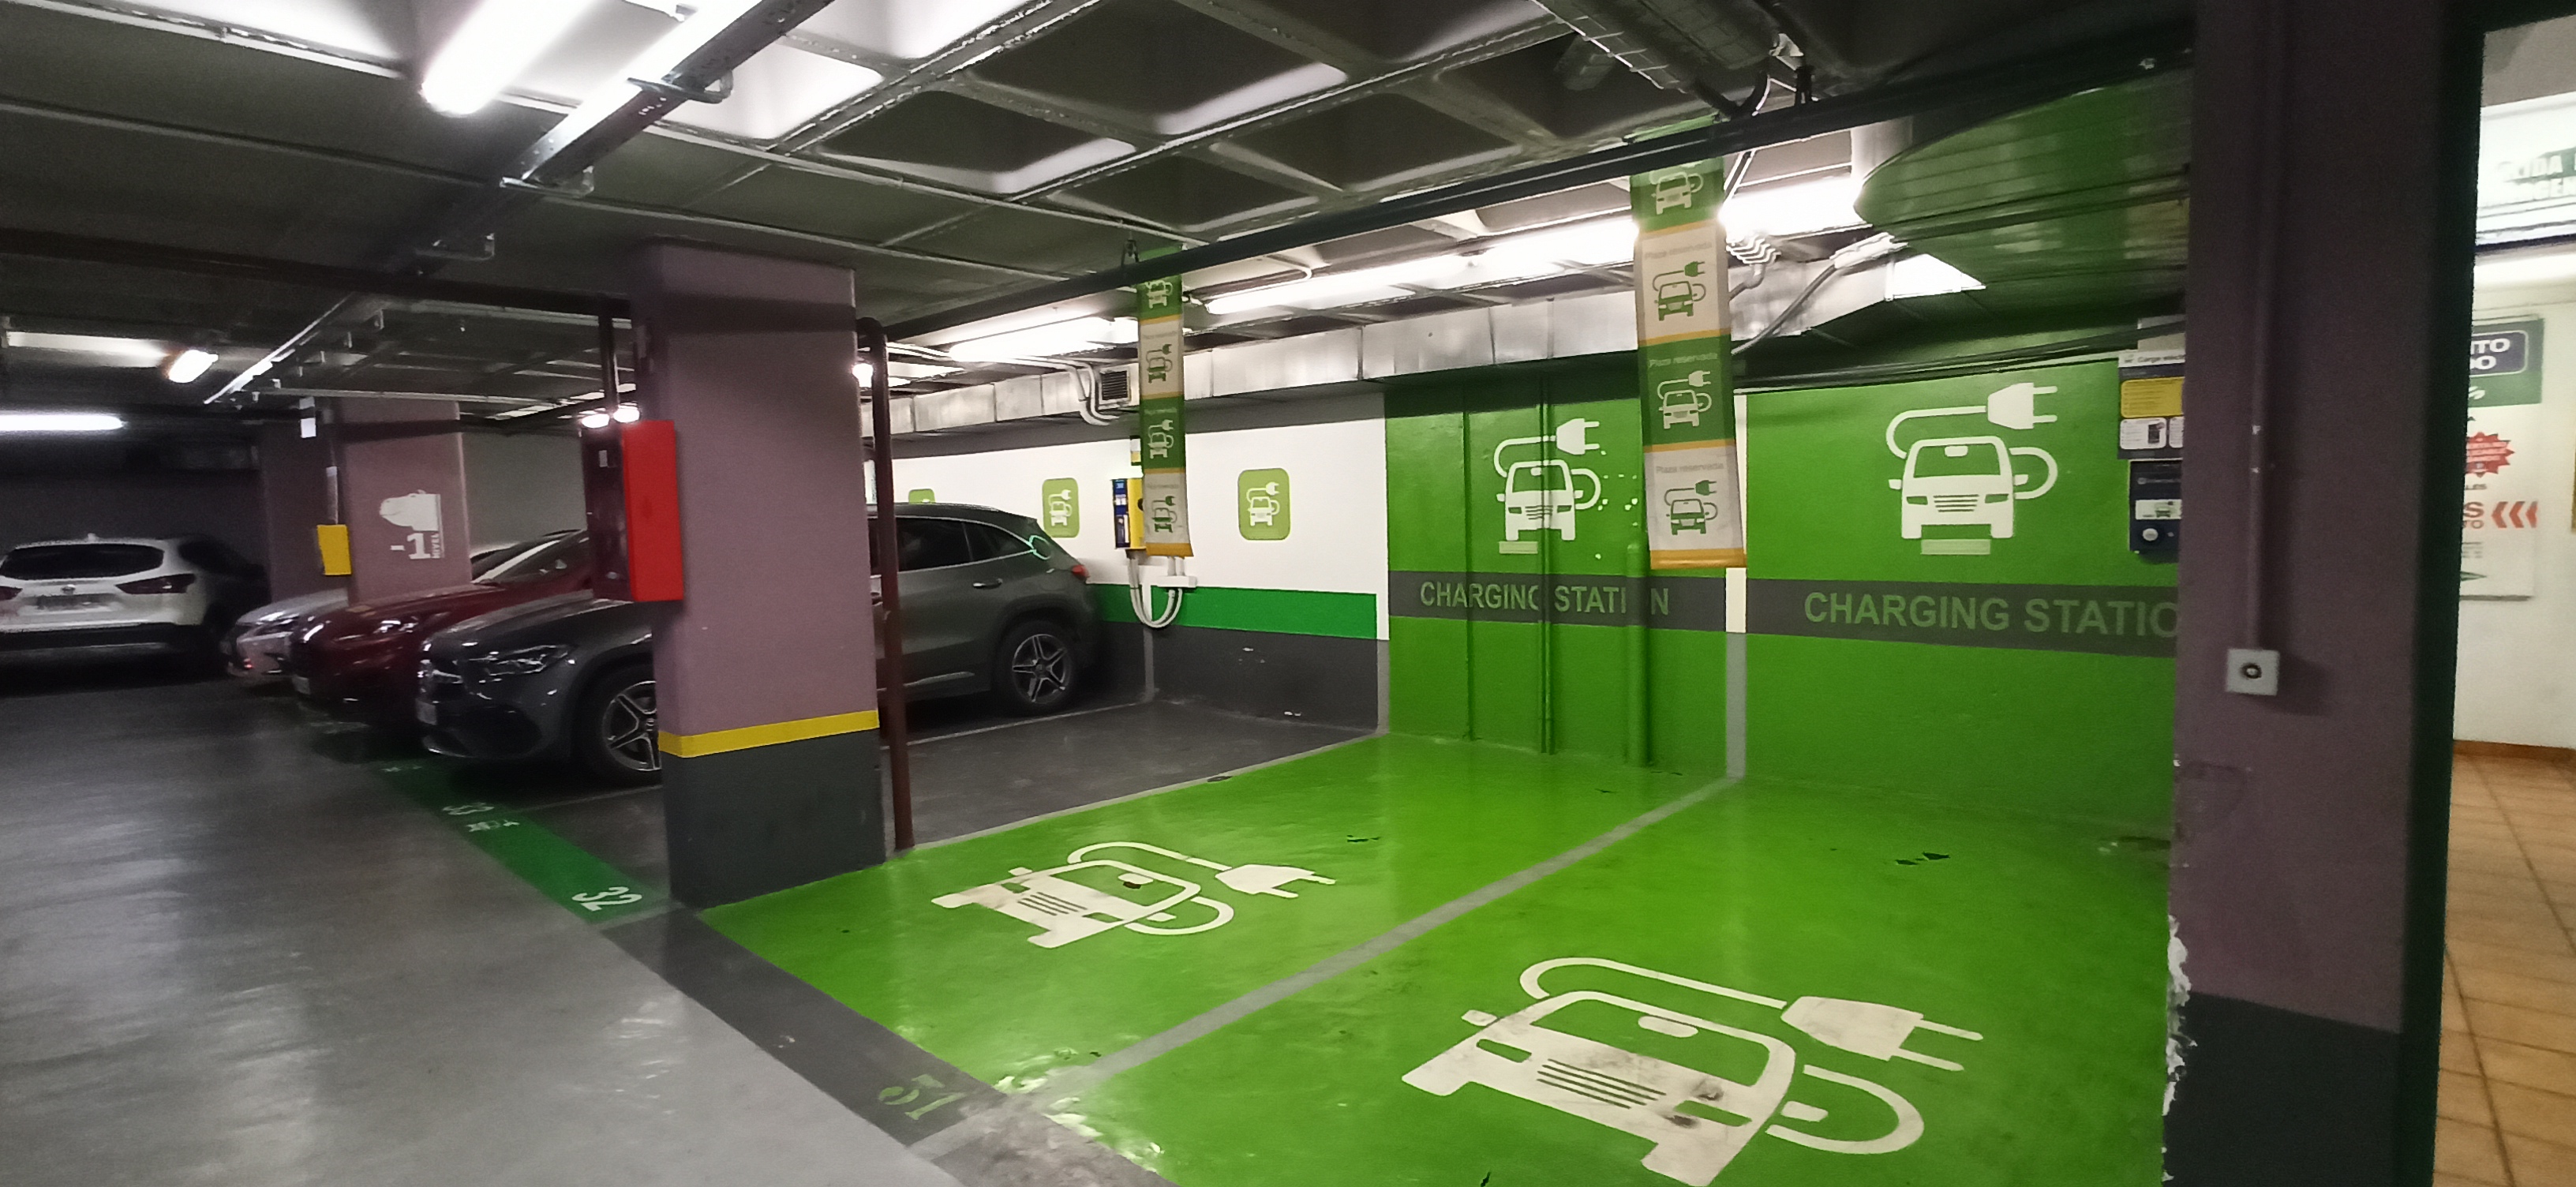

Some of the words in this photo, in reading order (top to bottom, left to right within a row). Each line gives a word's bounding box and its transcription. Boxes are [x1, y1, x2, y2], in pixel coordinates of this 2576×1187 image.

[1555, 586, 1669, 615] STATIN
[1804, 592, 2009, 631] CHARGING
[2024, 598, 2178, 638] STATIO
[571, 886, 642, 912] 32
